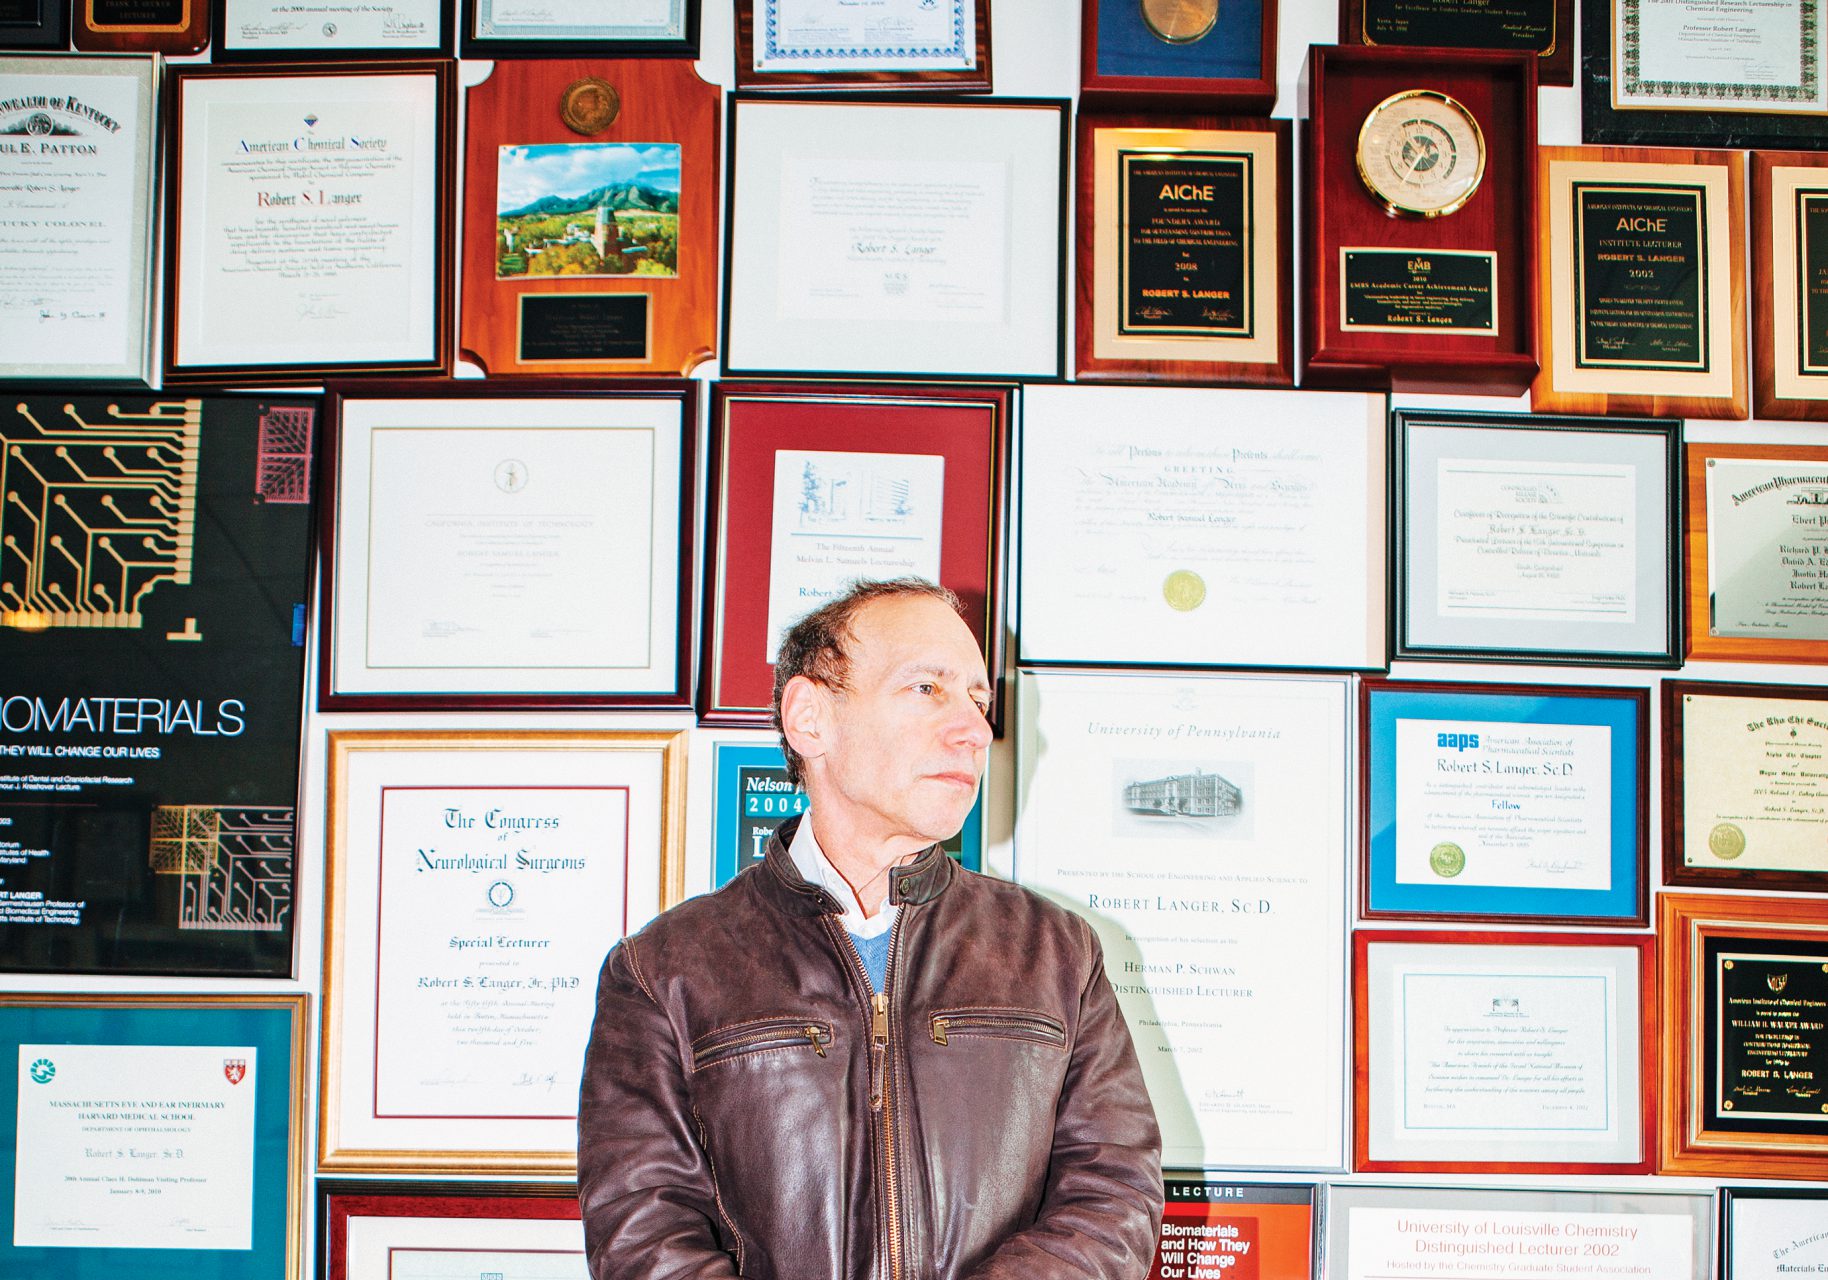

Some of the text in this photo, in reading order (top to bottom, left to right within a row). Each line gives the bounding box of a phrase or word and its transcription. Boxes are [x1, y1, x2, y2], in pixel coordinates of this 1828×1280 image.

[41, 143, 98, 155] PATTON
[1159, 184, 1214, 201] AIChE
[1616, 218, 1668, 232] AIChE
[1408, 261, 1431, 270] EMB
[1648, 255, 1685, 263] LANGER
[1629, 270, 1654, 278] 2002
[1142, 289, 1179, 297] ROBERT
[1193, 290, 1230, 299] LANGER
[800, 587, 832, 597] Robert
[1087, 721, 1282, 741] University of Pennsylvania
[1438, 733, 1479, 752] aaps
[27, 746, 53, 757] WILL
[55, 746, 101, 758] CHANGE
[103, 747, 128, 758] OUR
[130, 748, 160, 758] LIVES
[1437, 759, 1477, 773] Robert
[746, 777, 792, 792] Nelson
[750, 798, 802, 812] 2004
[1492, 799, 1521, 810] Fellow
[444, 808, 560, 834] The Congress
[416, 848, 586, 874] Neurological Surgeons
[42, 908, 79, 916] Engineering
[44, 916, 80, 925] Technology
[449, 936, 551, 950] Special Lecturer
[1124, 960, 1172, 975] HERMAN
[1197, 984, 1254, 998] LECTURER
[1741, 1069, 1769, 1078] ROBERT
[1784, 1070, 1814, 1080] LANGER
[49, 1100, 226, 1110] MASSACHUSETTS EYE AND EAR INFIRMARY
[78, 1112, 196, 1121] HARVARD MEDICAL SCHOOL
[1172, 1186, 1244, 1198] LECTURE
[1161, 1223, 1239, 1238] Biomaterials
[1396, 1219, 1638, 1240] University of Louisville Chemistry
[1161, 1238, 1250, 1254] and How They
[1415, 1239, 1620, 1257] Distinguished Lecturer 2002
[1161, 1252, 1236, 1268] Will Change
[1386, 1260, 1651, 1274] Hosted by the Chemistry Graduate Student Association
[1160, 1266, 1221, 1280] Our Lives
